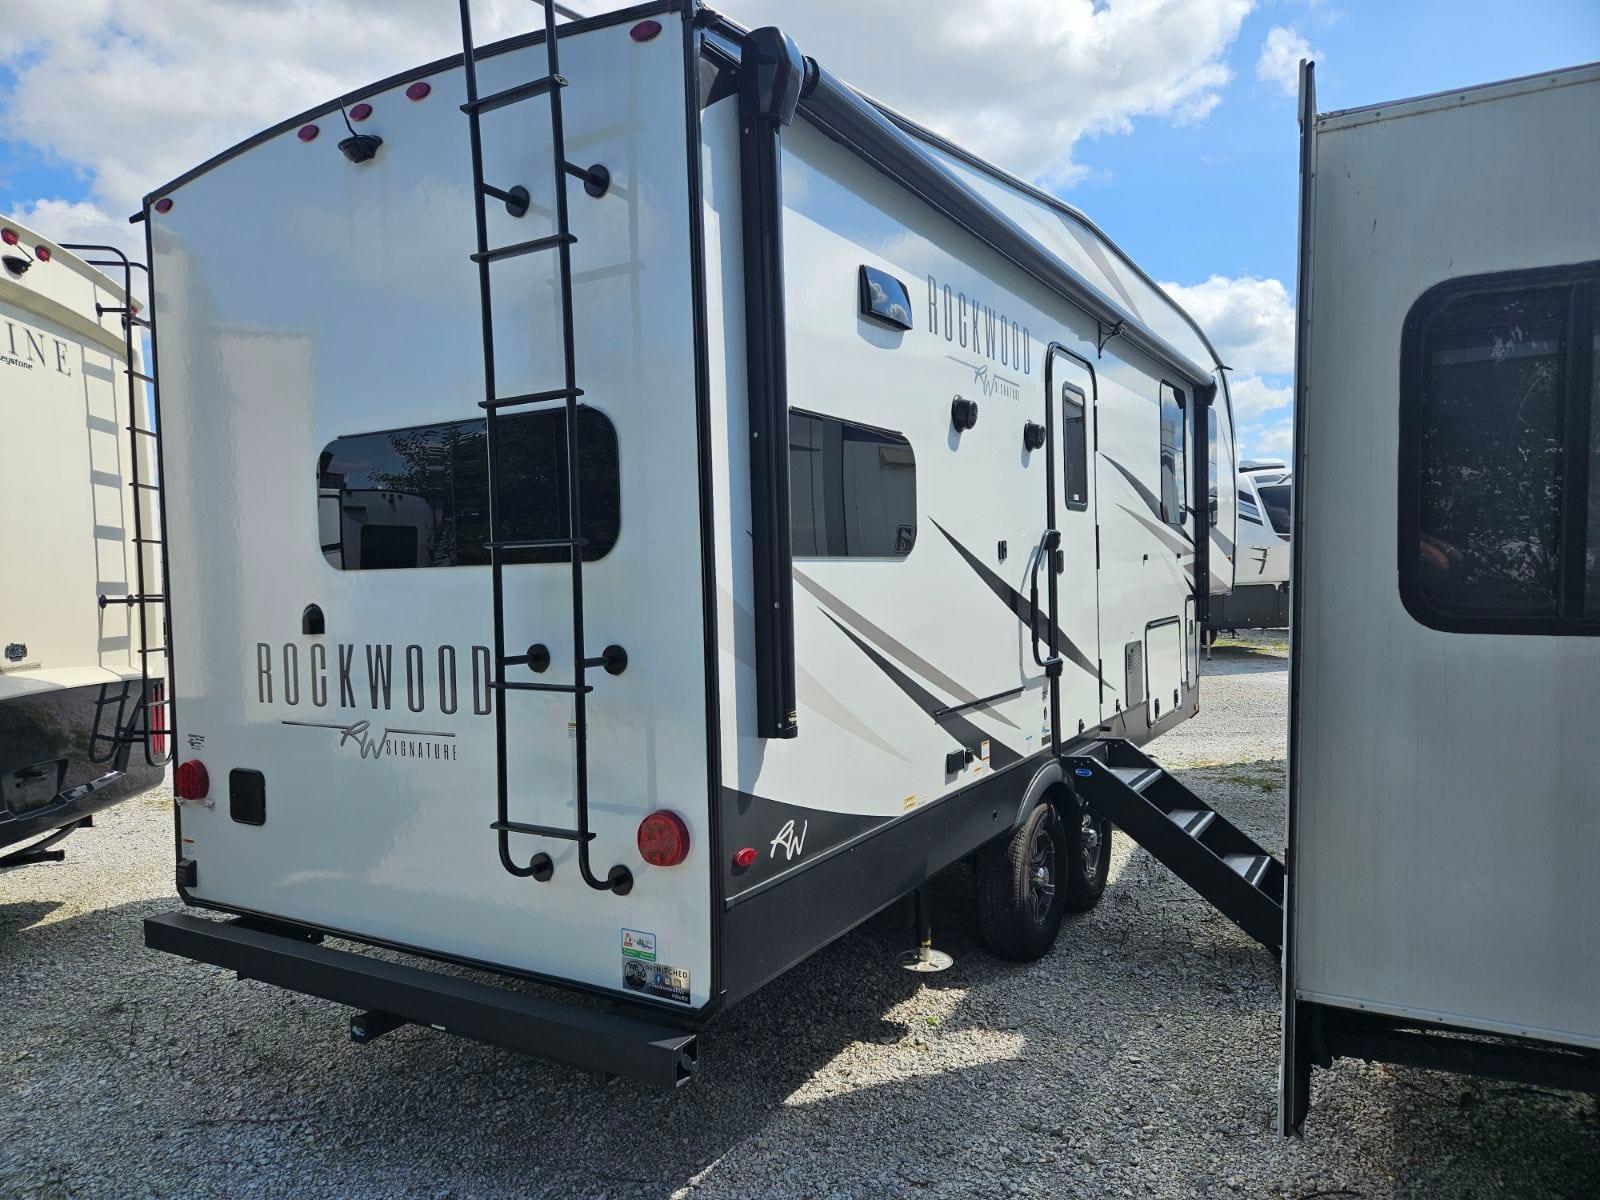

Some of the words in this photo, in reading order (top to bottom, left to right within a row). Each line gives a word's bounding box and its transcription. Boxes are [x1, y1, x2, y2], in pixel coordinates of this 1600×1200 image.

[927, 273, 1030, 375] ROCKWOOD
[256, 642, 493, 716] ROCKWOOD
[386, 739, 458, 761] SIGNATURE
